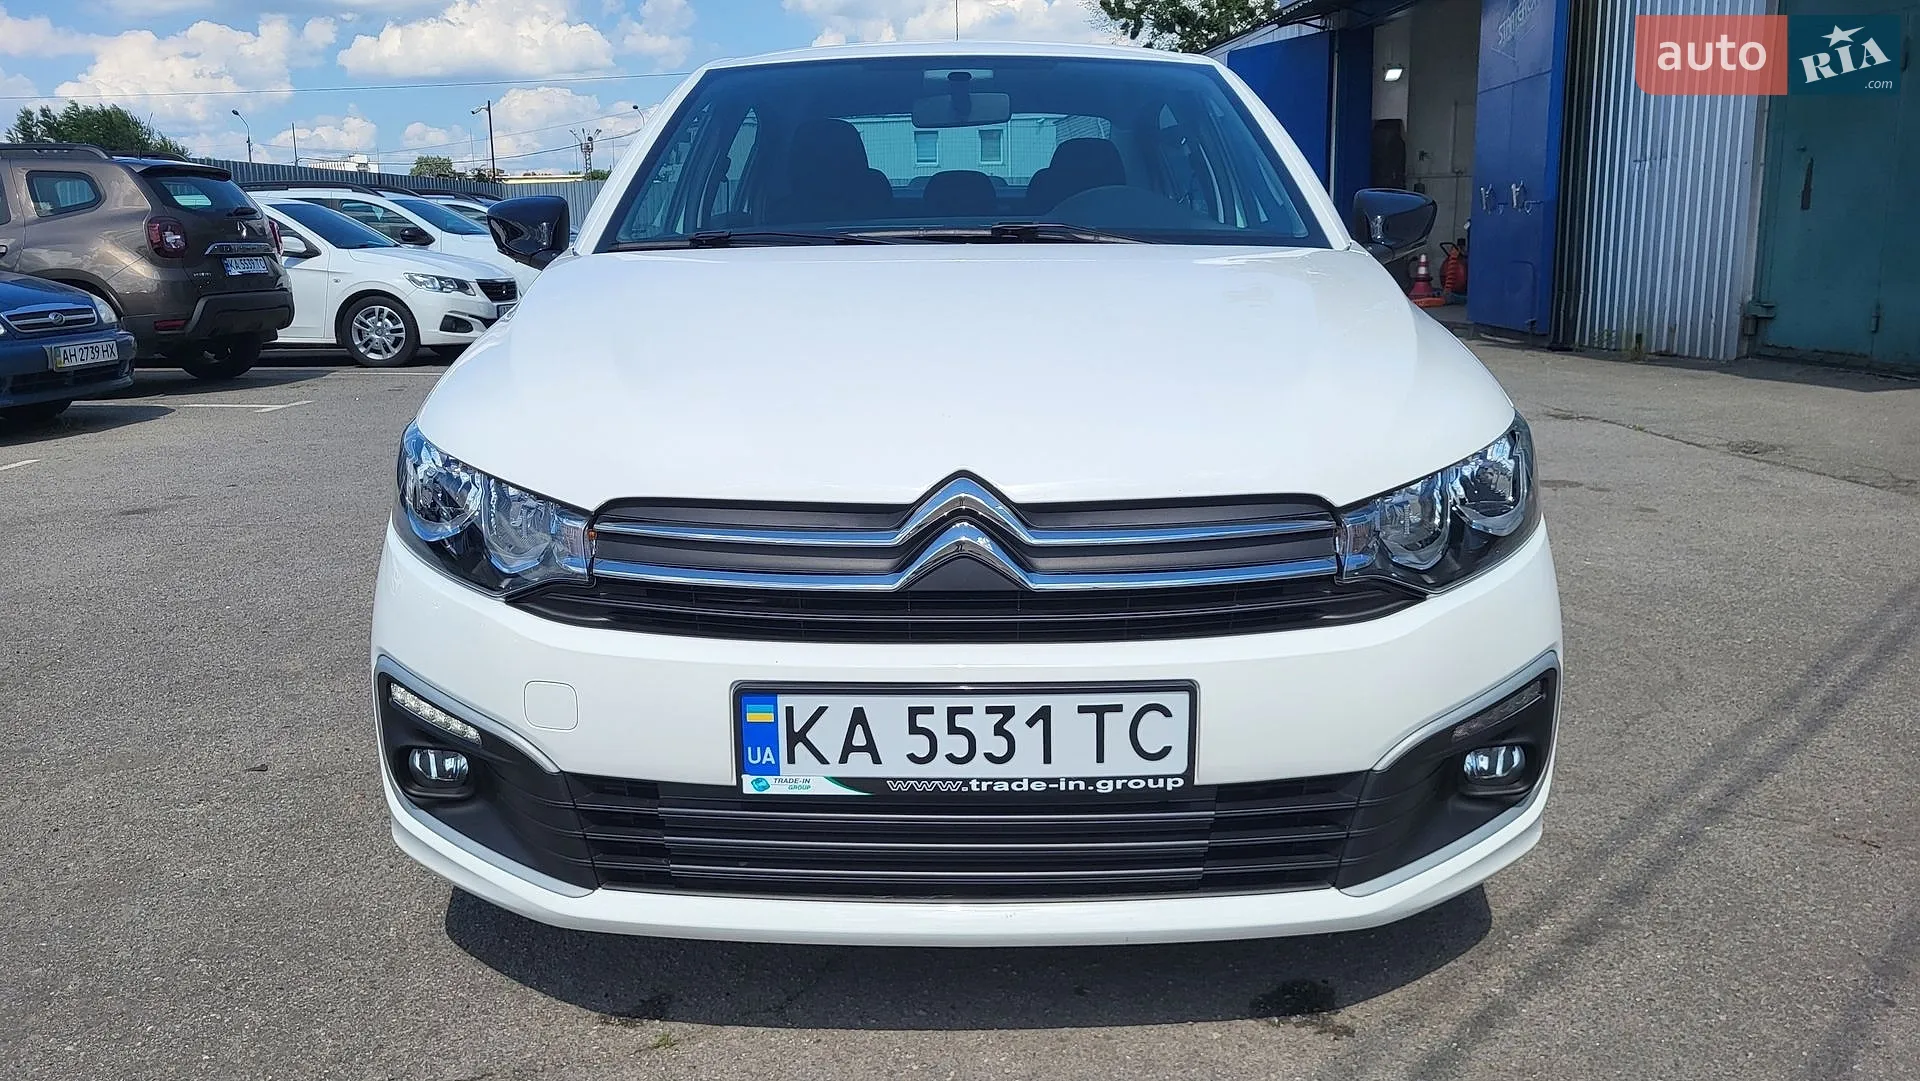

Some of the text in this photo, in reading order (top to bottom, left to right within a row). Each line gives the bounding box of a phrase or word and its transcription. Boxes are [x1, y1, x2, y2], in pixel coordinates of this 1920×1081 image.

[63, 343, 116, 363] AH 2739 HX
[785, 703, 1173, 765] KA 5531 TC
[747, 747, 776, 765] UA
[887, 776, 1185, 793] www.trade-in.group
